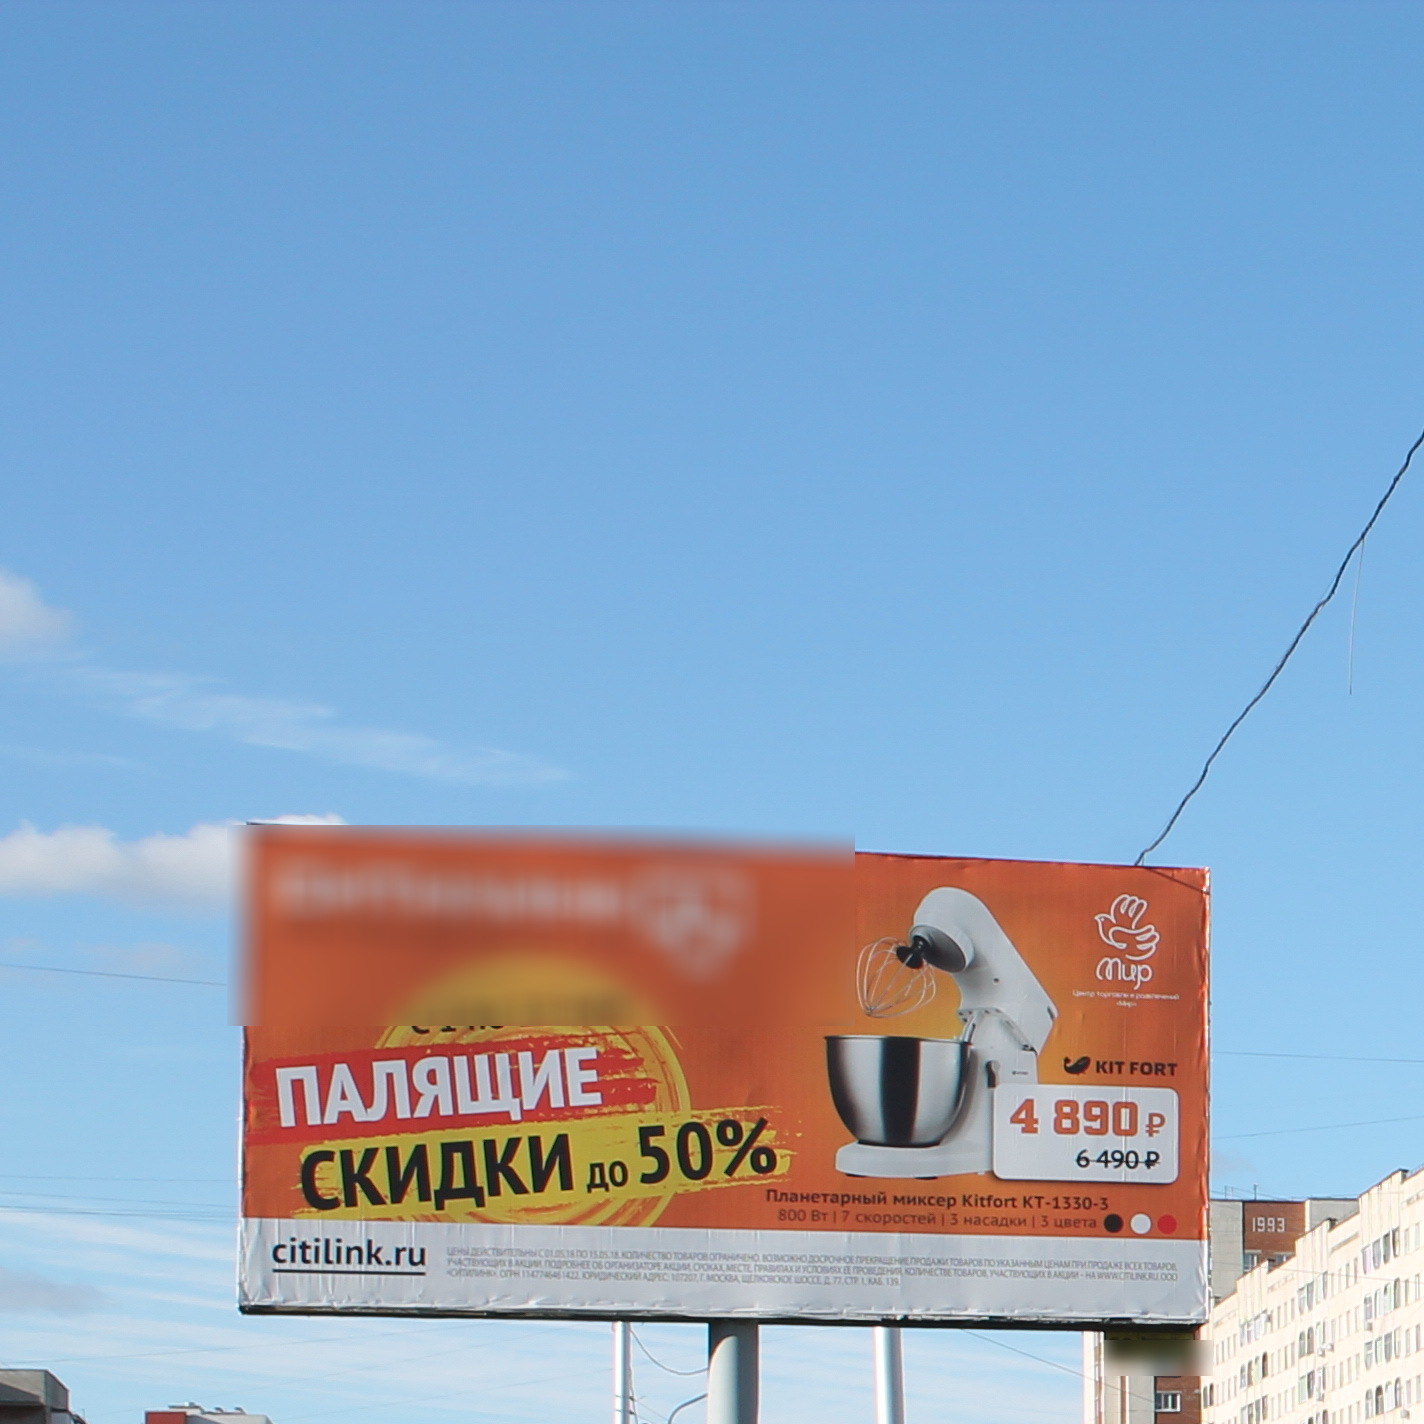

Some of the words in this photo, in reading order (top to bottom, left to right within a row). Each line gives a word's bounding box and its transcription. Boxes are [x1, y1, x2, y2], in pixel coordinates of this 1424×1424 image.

[1096, 957, 1153, 990] Мир
[1096, 1060, 1123, 1075] KIT
[1130, 1062, 1178, 1076] FORT
[276, 1047, 602, 1128] ПАЛЯЩИЕ
[1010, 1098, 1039, 1135] 4
[1054, 1099, 1139, 1137] 890
[301, 1132, 574, 1211] СКИДКИ
[587, 1159, 629, 1194] до
[638, 1117, 778, 1185] 50%
[767, 1189, 888, 1207] Планетарный
[894, 1195, 958, 1210] миксер
[962, 1194, 1017, 1209] Kitfort
[778, 1209, 807, 1222] 800
[811, 1209, 829, 1223] Вт
[855, 1211, 937, 1226] скоростей
[963, 1214, 1027, 1229] насадки
[1054, 1217, 1097, 1231] цвета
[1252, 1217, 1285, 1233] 1993
[273, 1238, 427, 1268] citilink.ru
